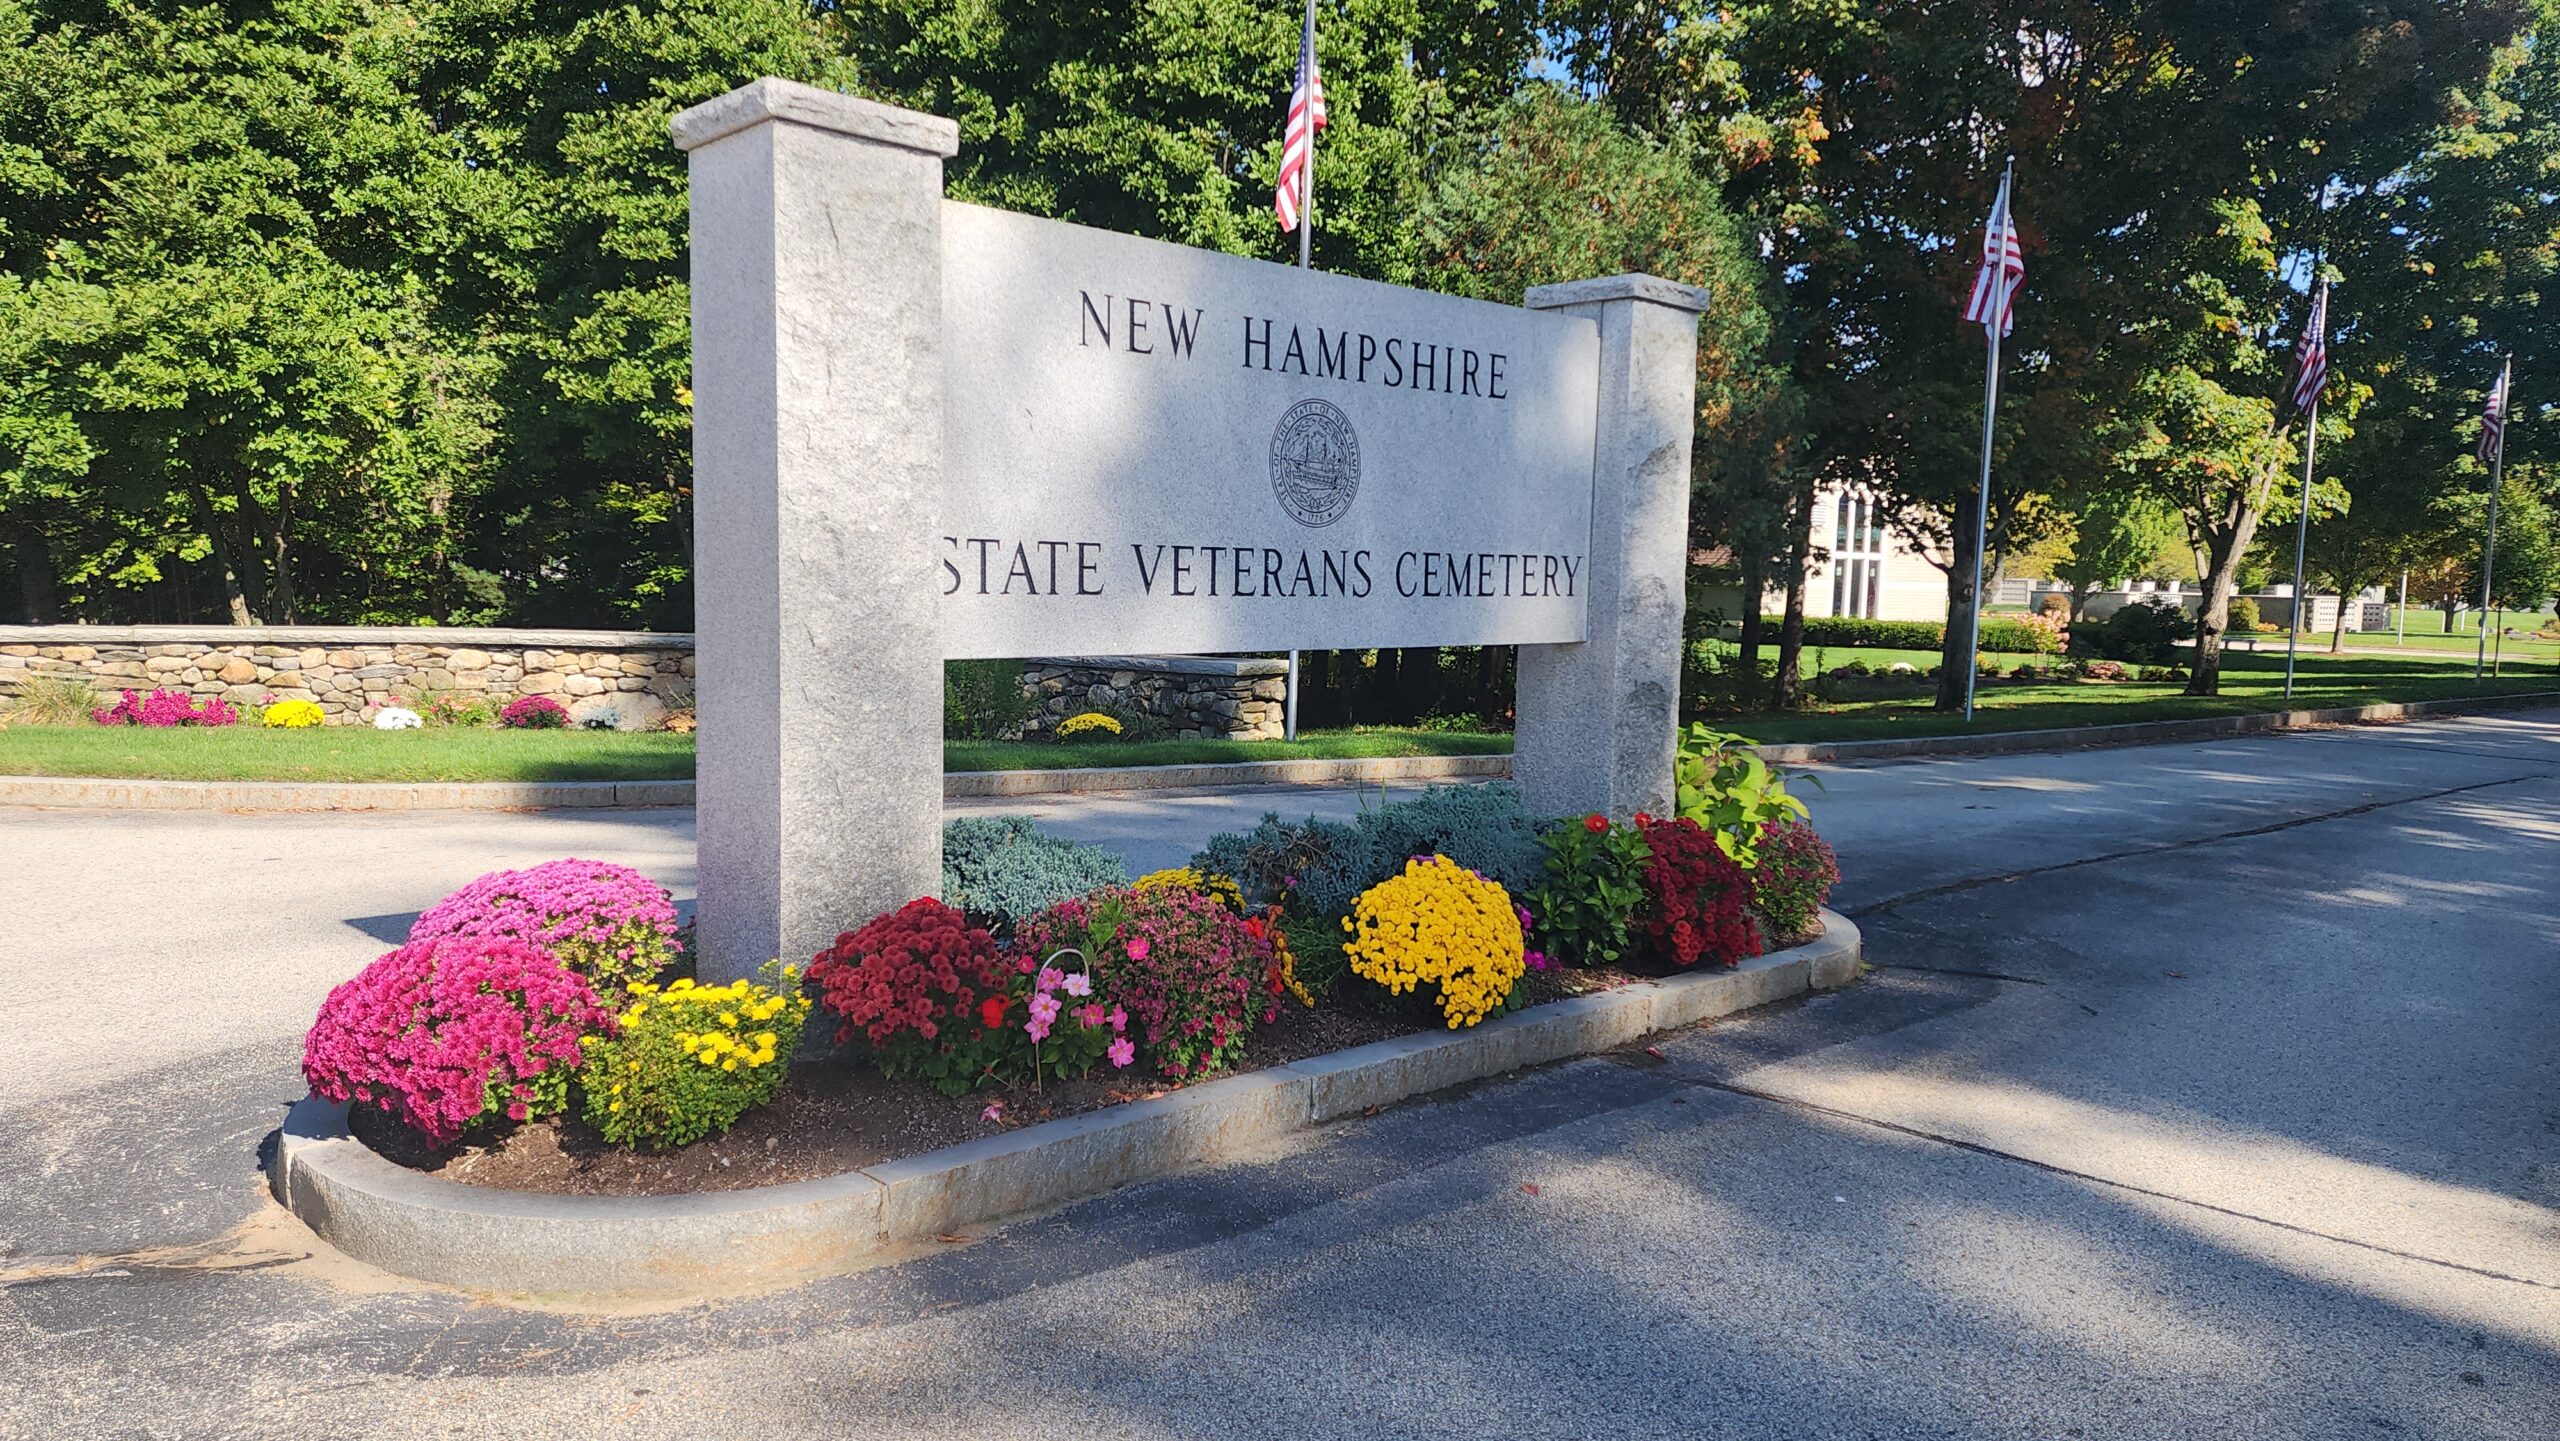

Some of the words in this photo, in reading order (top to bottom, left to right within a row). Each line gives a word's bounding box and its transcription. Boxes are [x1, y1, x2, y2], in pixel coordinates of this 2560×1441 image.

[1079, 290, 1204, 360] NEW
[1242, 316, 1508, 399] HAMPSHIRE
[1277, 423, 1289, 442] THE
[1290, 404, 1313, 421] STATE
[1319, 405, 1330, 415] OF
[1334, 415, 1350, 435] NEW
[1342, 441, 1358, 504] HAMPSHIRE
[1307, 513, 1324, 523] 1776
[944, 536, 1105, 595] STATE
[1130, 544, 1372, 598] VETERANS
[1396, 551, 1583, 598] CEMETERY
